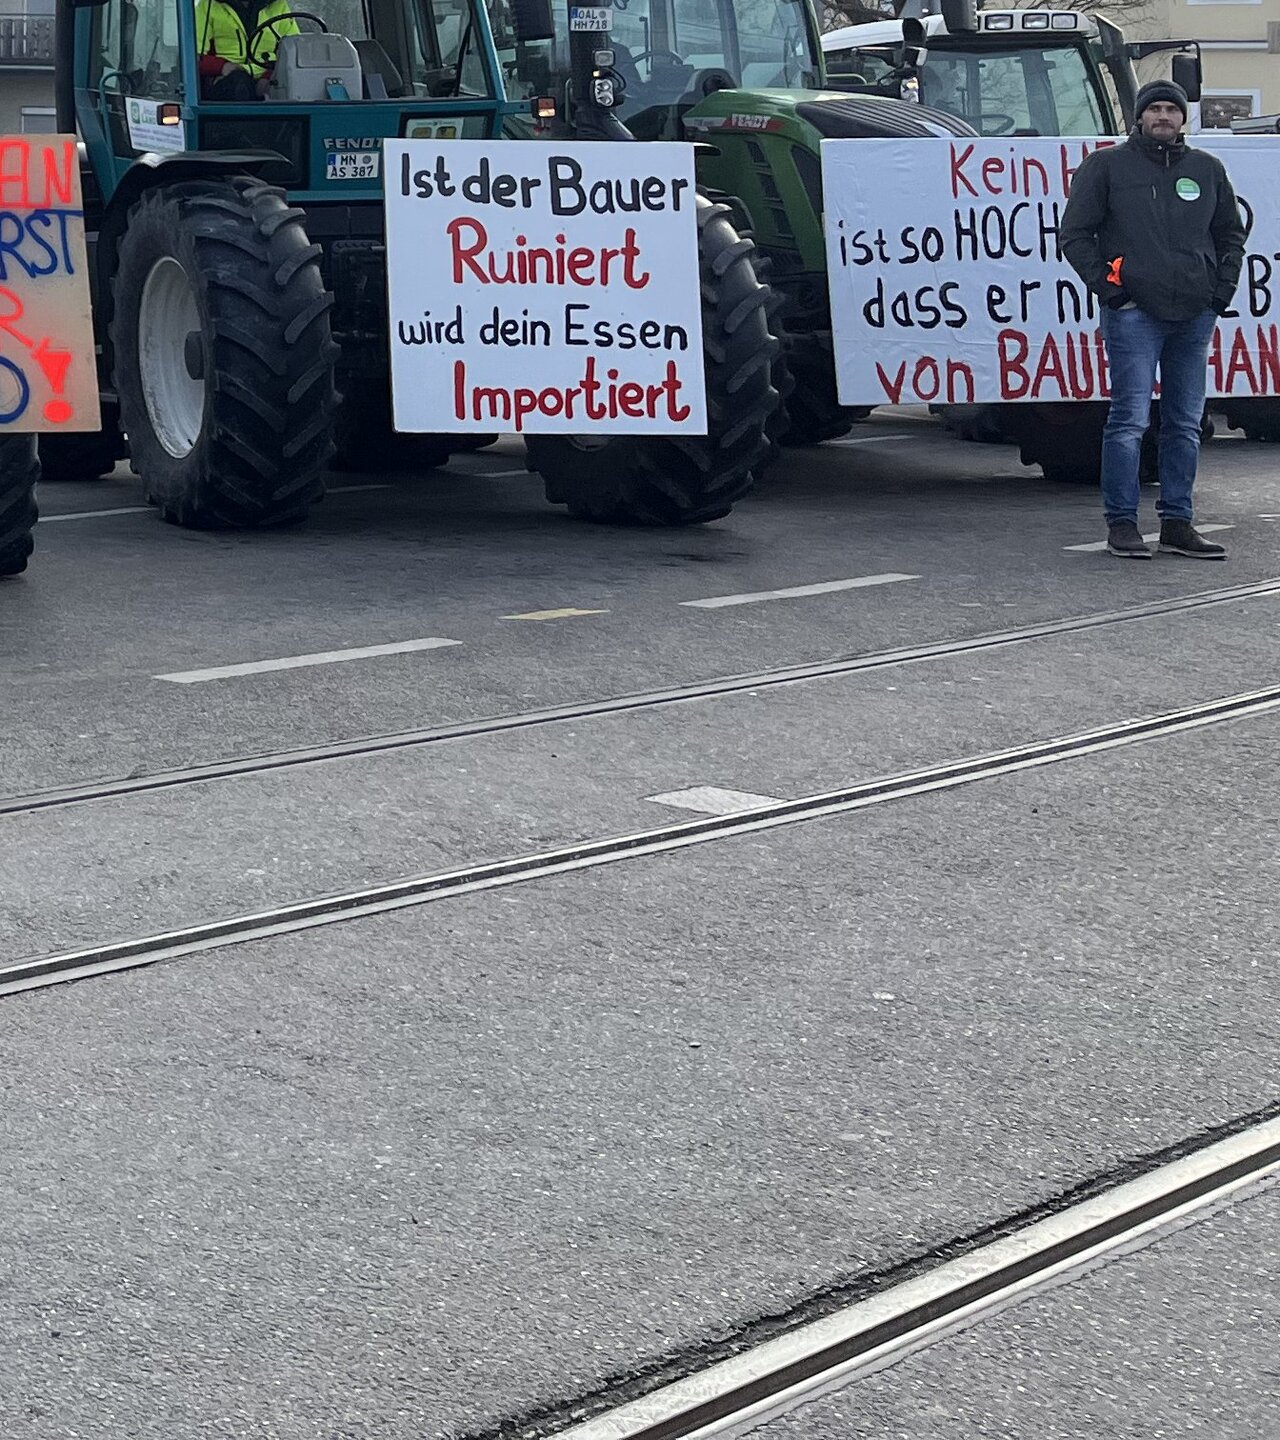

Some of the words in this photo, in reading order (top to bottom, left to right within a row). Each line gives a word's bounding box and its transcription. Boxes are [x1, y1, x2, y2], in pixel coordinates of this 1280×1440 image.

[579, 9, 597, 19] OAL
[330, 166, 346, 178] AS
[351, 165, 373, 177] 387
[340, 154, 356, 165] MN
[401, 152, 456, 199] Ist
[462, 157, 541, 208] der
[548, 156, 689, 216] Bauer
[950, 142, 1049, 199] Kein
[446, 216, 650, 289] Ruiniert
[838, 220, 891, 266] ist
[898, 227, 944, 264] so
[398, 305, 465, 345] wird
[479, 306, 551, 346] dein
[565, 303, 689, 351] Essen
[862, 277, 967, 328] dass
[986, 280, 1041, 323] er
[453, 356, 691, 432] Importiert
[875, 355, 974, 404] von
